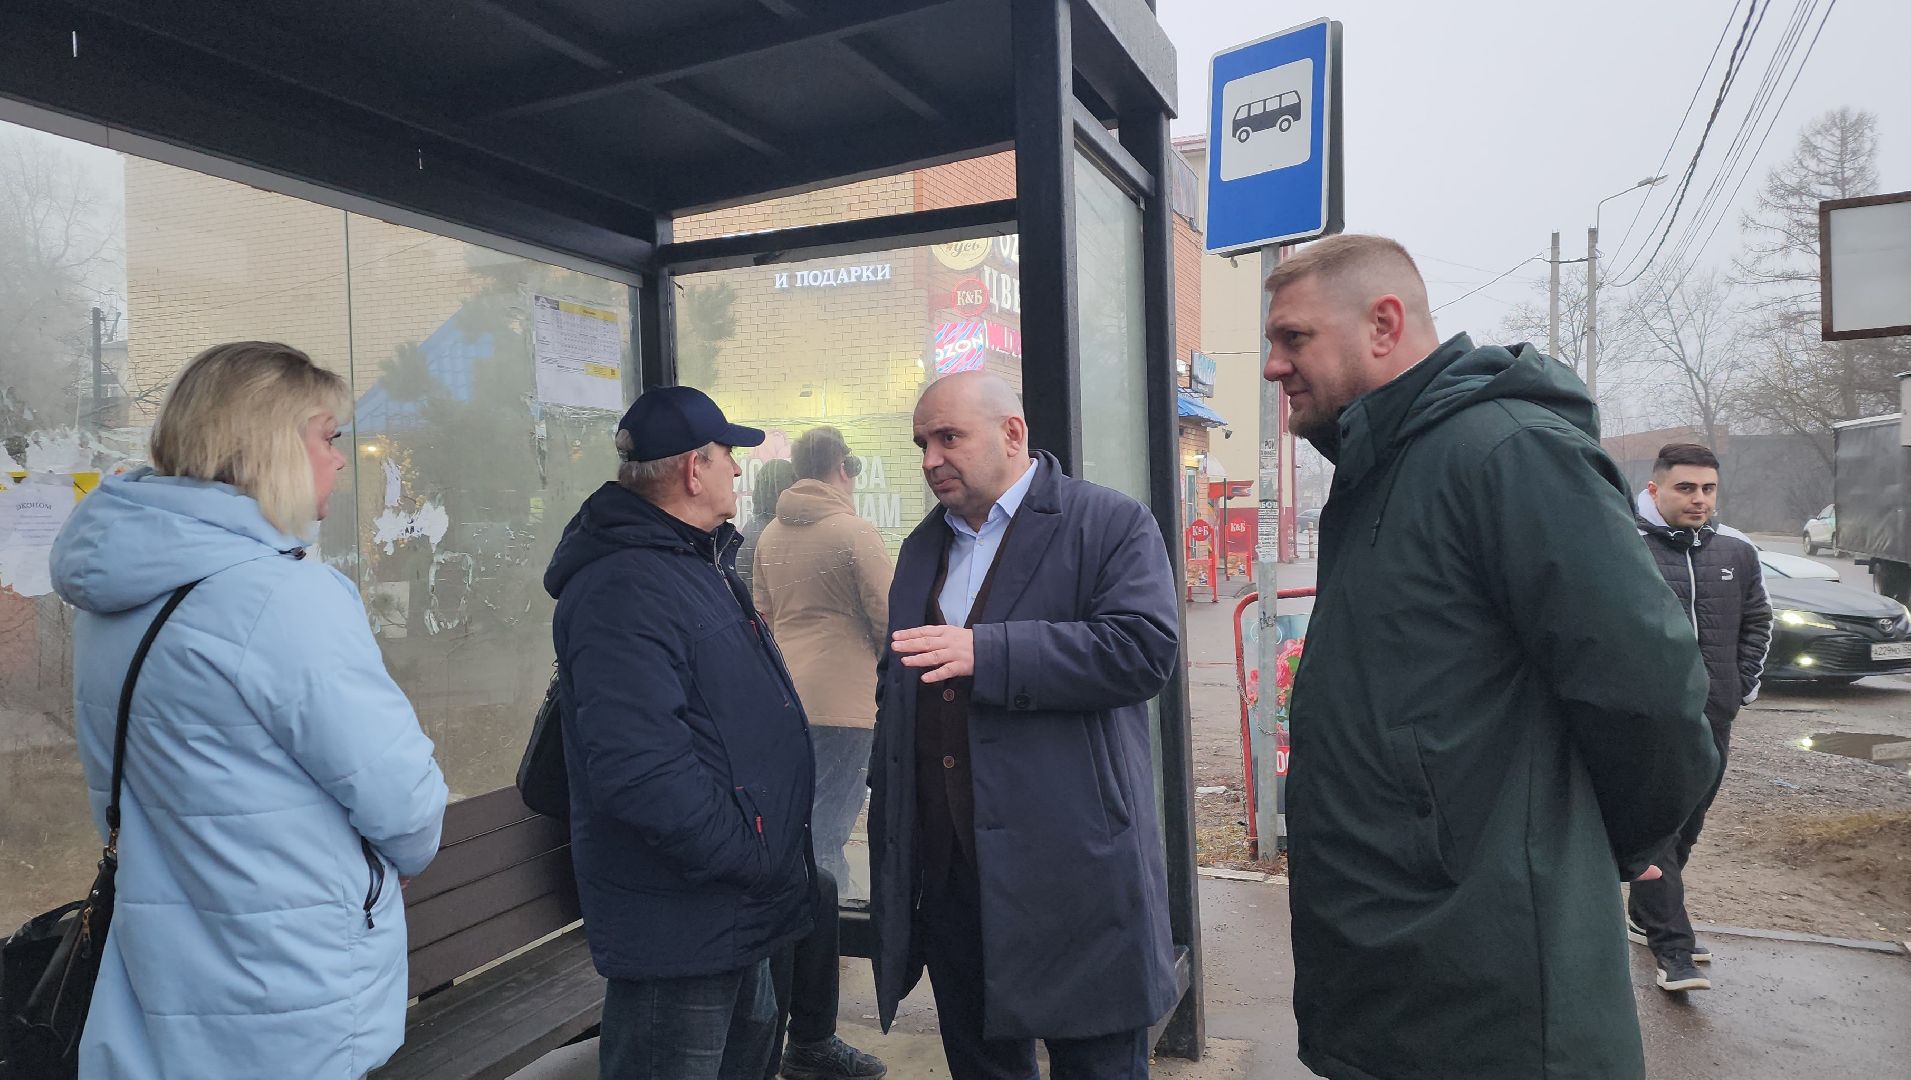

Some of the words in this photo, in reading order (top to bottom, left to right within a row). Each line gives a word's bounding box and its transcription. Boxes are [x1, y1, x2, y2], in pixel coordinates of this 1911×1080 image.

[774, 272, 790, 289] И
[795, 263, 891, 288] ПОДАРКИ
[956, 289, 983, 306] К&Б
[1192, 525, 1209, 536] К&Б
[1230, 521, 1246, 533] К&Б
